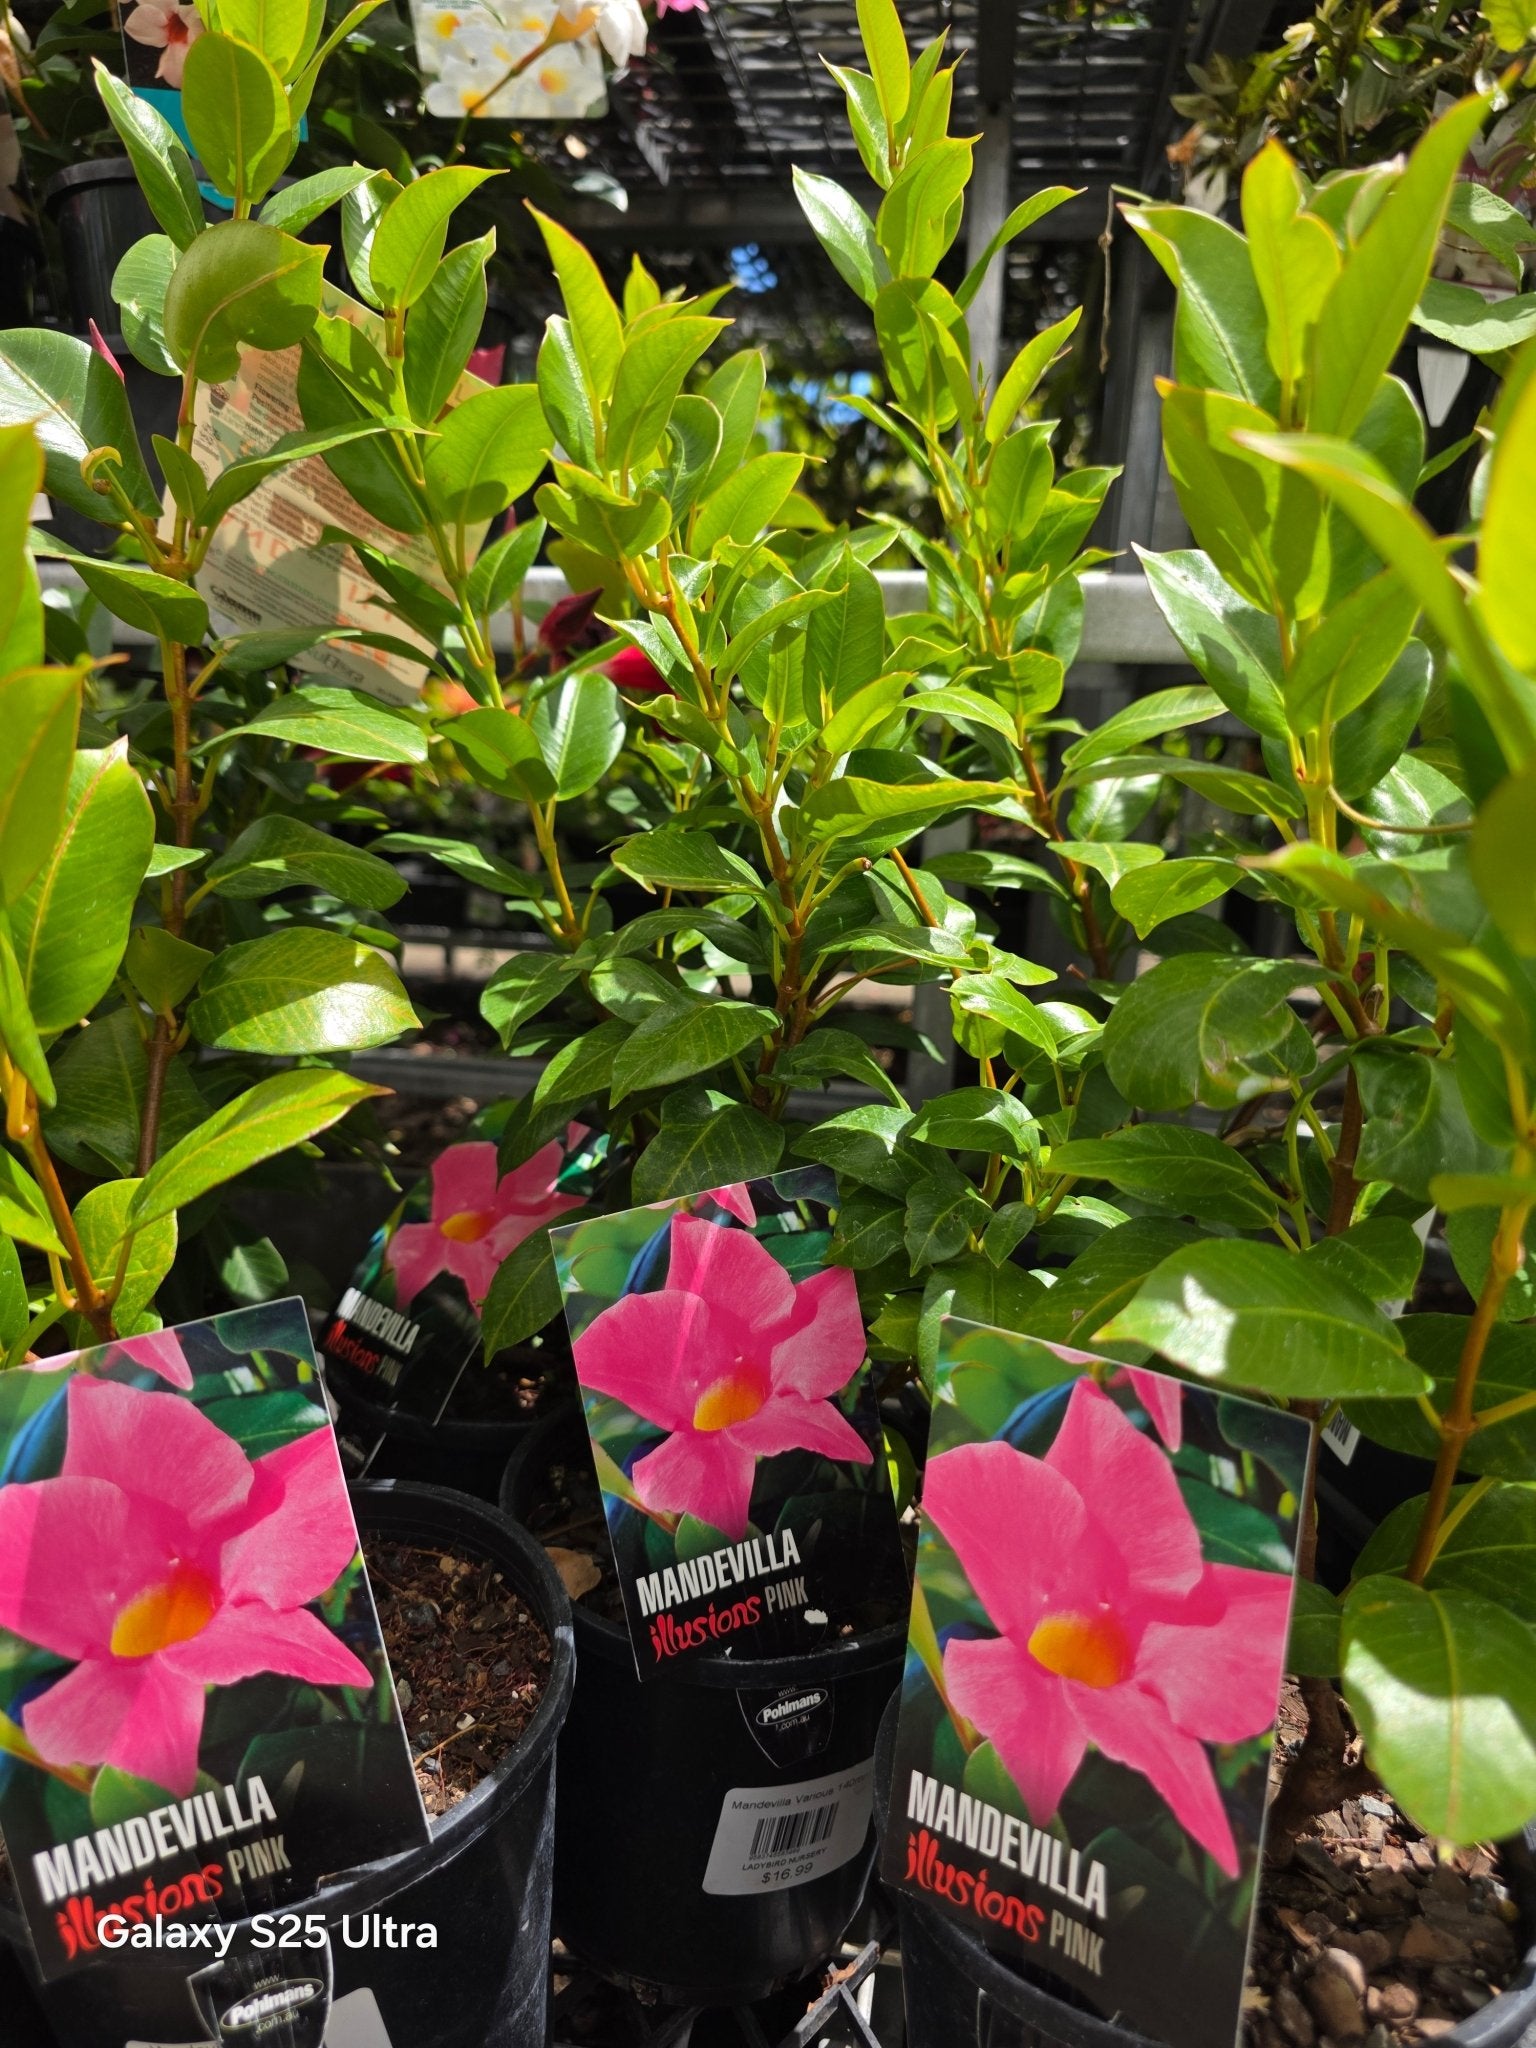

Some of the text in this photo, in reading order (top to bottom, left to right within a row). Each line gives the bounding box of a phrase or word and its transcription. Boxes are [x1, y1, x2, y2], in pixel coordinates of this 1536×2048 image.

[335, 1287, 420, 1354] MANDEVILLA
[636, 1528, 801, 1617] MANDEVILLA
[650, 1576, 809, 1663] illusions PINK
[763, 1692, 821, 1723] Pohlmans
[33, 1775, 277, 1904] MANDEVILLA
[731, 1797, 792, 1810] Mandevilla
[795, 1788, 834, 1804] Various
[761, 1862, 814, 1885] $16.99
[907, 1769, 1107, 1919] MANDEVILLA
[56, 1834, 292, 1960] illusions PINK
[904, 1829, 1104, 1976] illusions PINK
[230, 1983, 315, 2026] Pohlmans
